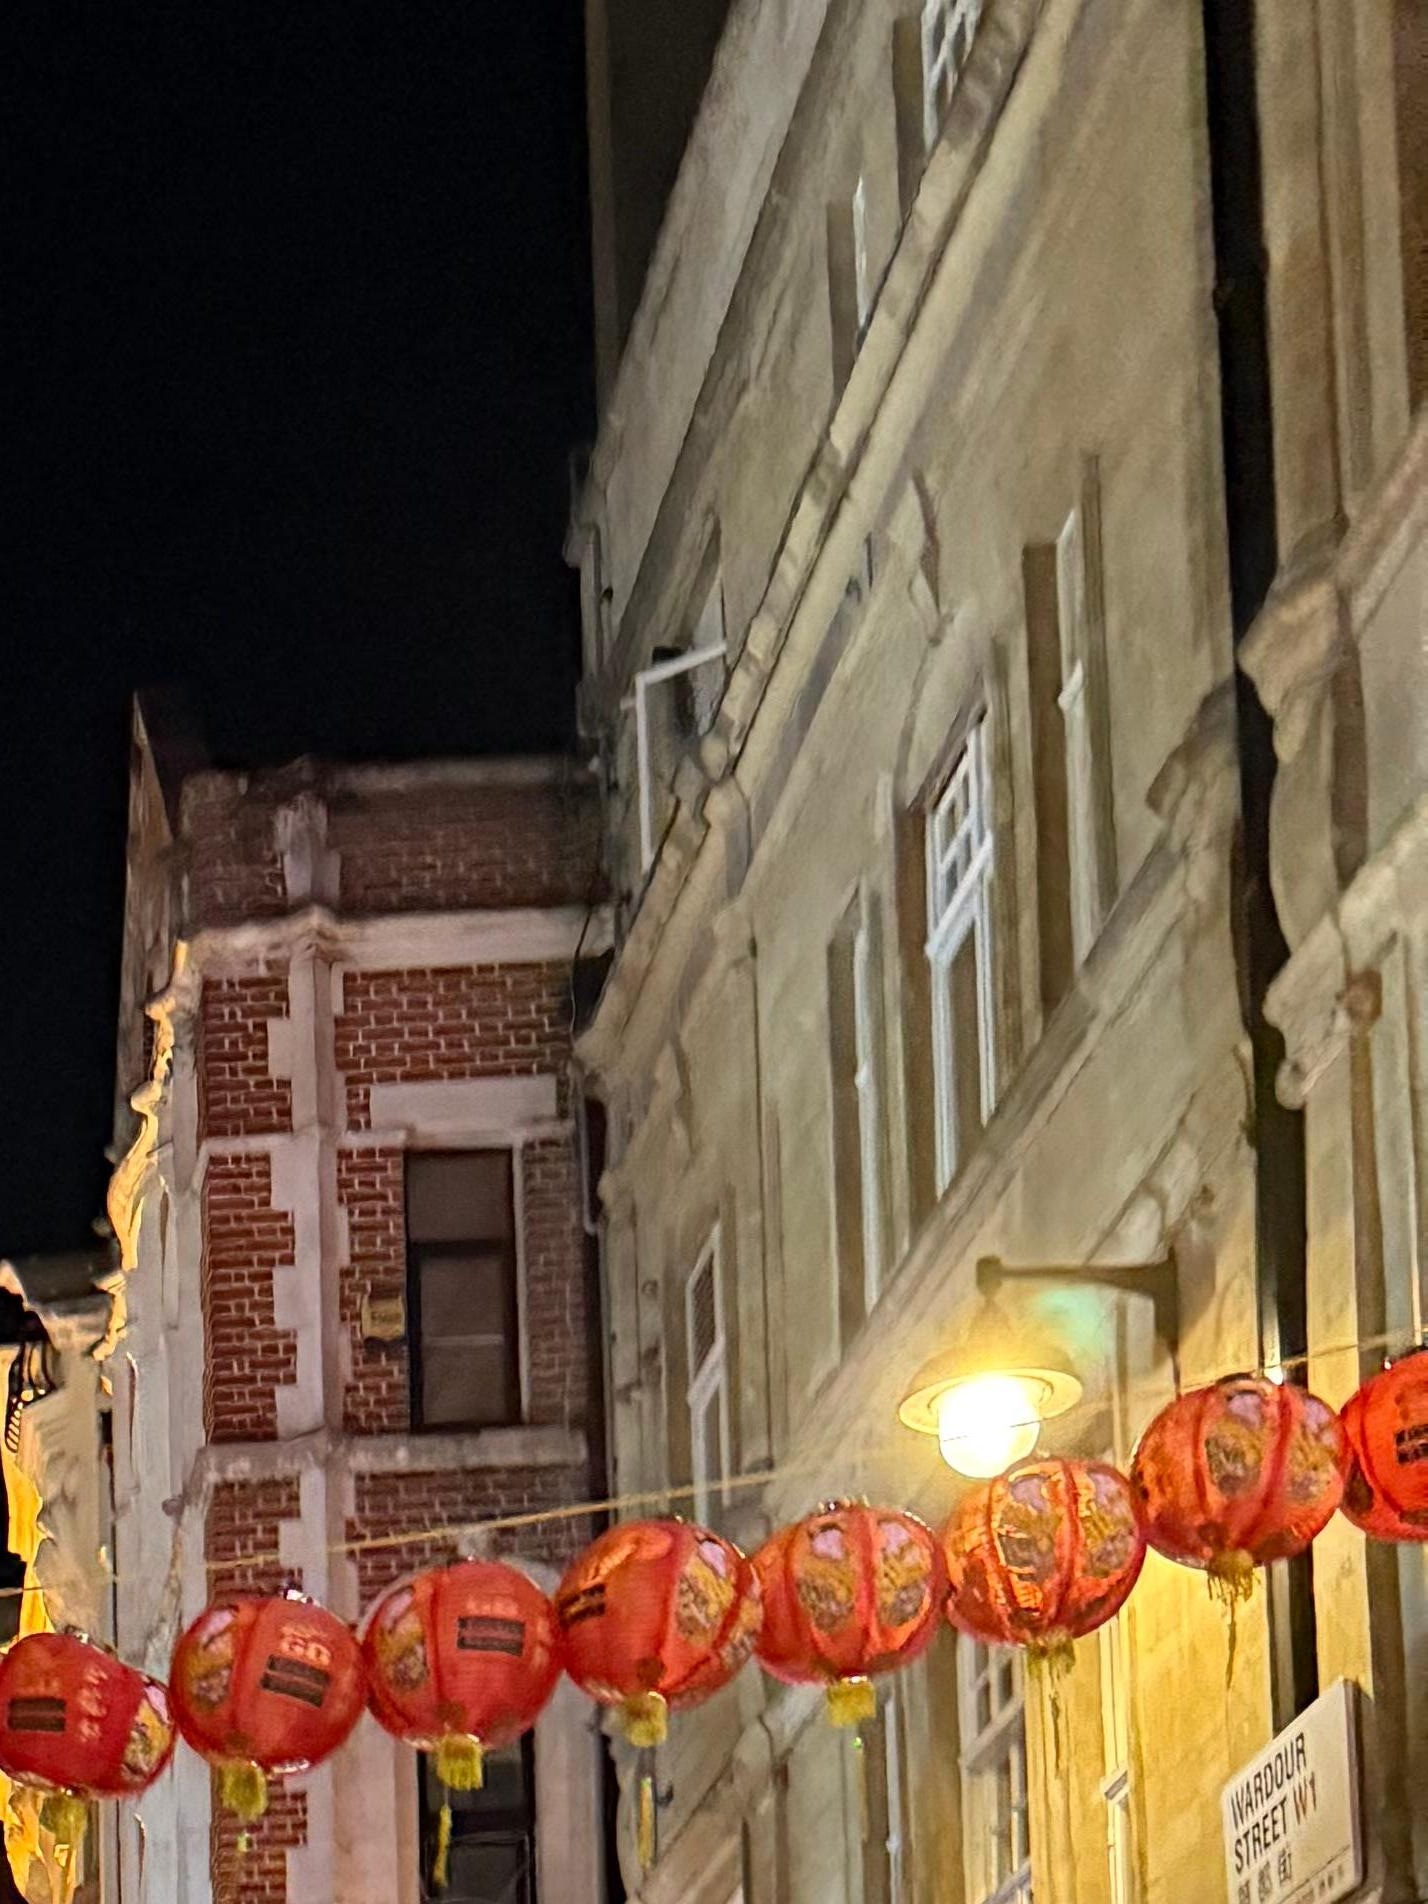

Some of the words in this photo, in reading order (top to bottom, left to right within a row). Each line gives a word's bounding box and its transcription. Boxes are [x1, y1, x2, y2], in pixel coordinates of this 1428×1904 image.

[1230, 1731, 1308, 1831] WARDOUR
[1233, 1795, 1288, 1875] STREET
[1294, 1771, 1318, 1826] W1
